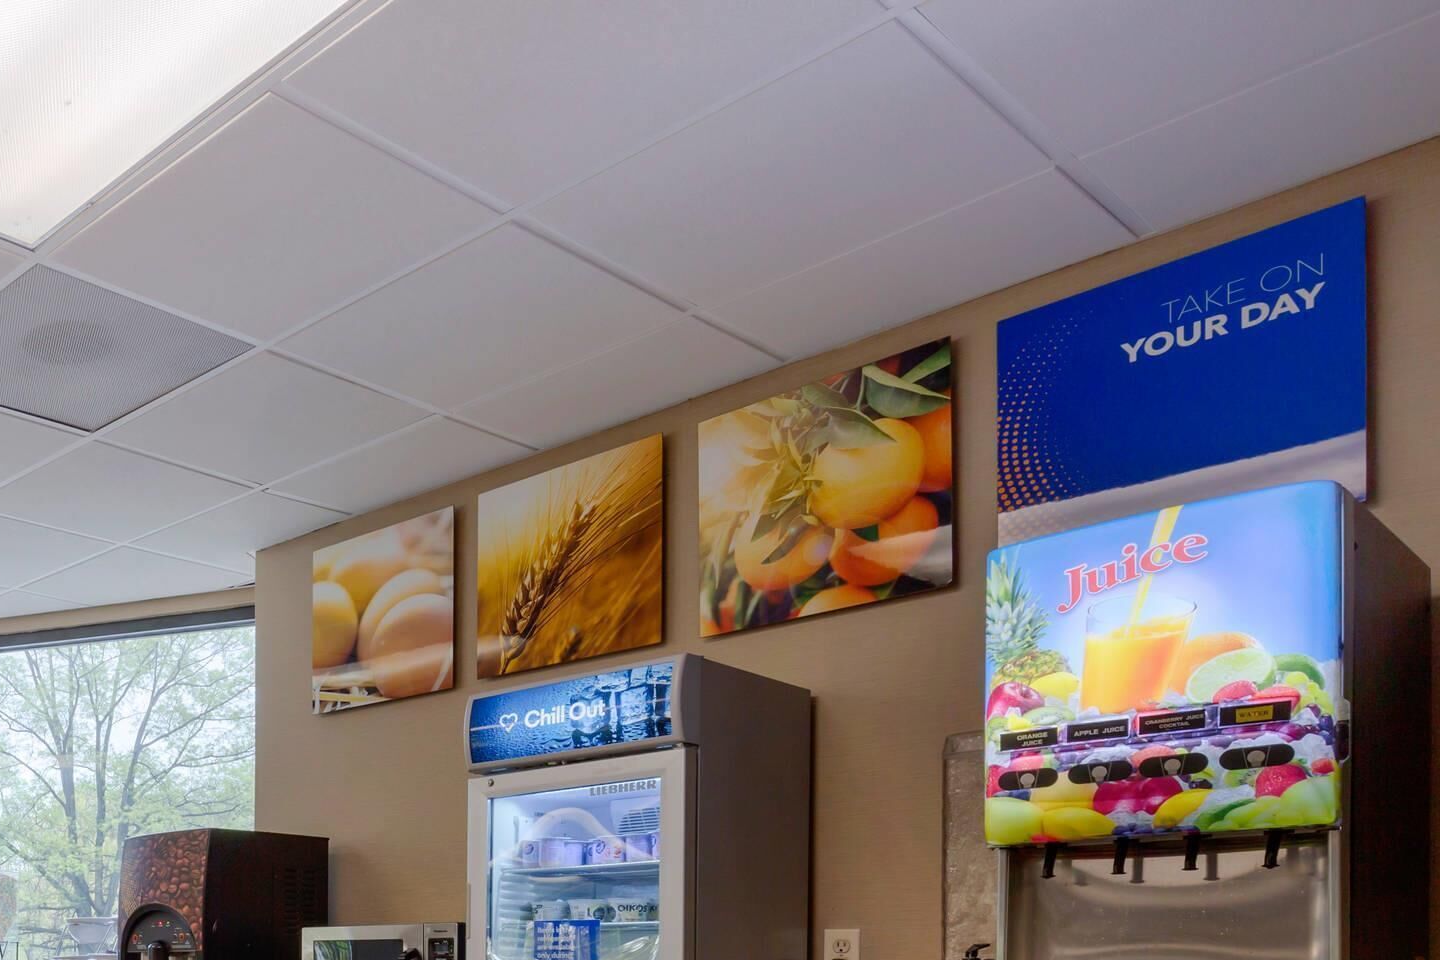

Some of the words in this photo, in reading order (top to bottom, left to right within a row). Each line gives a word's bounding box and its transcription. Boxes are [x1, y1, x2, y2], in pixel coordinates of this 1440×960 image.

[1161, 277, 1246, 323] TAKE
[1260, 252, 1324, 292] ON
[1120, 314, 1229, 363] YOUR
[1241, 281, 1325, 329] DAY
[1056, 533, 1208, 614] Juice
[524, 705, 566, 728] Chill
[569, 700, 606, 720] Out
[1144, 716, 1184, 726] CRANBERRY
[1185, 713, 1204, 721] JUICE
[1239, 710, 1269, 719] WATER
[1073, 728, 1099, 737] APPLE
[1101, 725, 1126, 734] JUICE
[1158, 721, 1191, 729] COCKTAIL
[1016, 731, 1049, 741] ORANGE
[1021, 739, 1043, 747] JUICE
[590, 779, 657, 796] LIEBHERR
